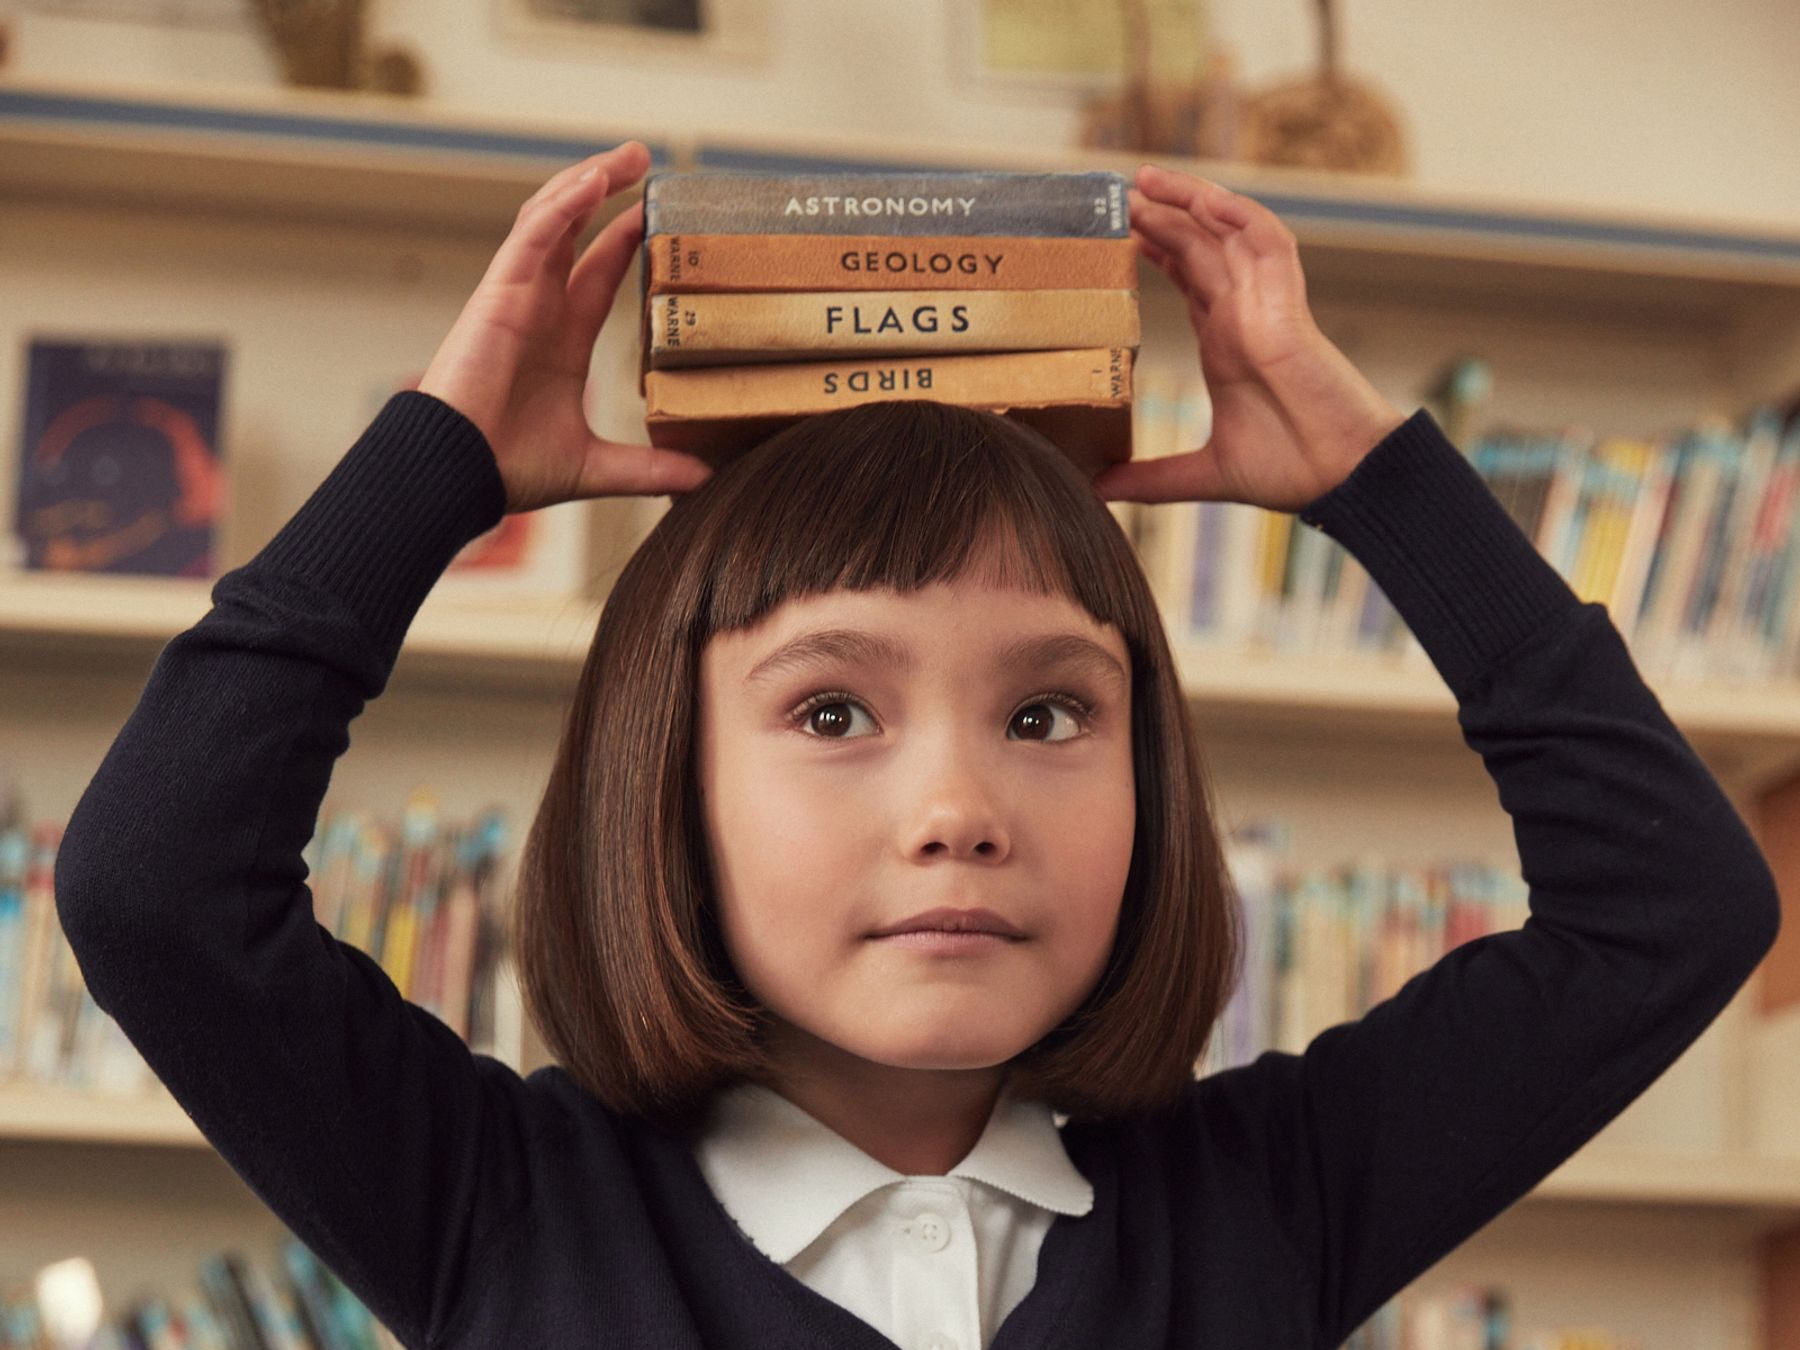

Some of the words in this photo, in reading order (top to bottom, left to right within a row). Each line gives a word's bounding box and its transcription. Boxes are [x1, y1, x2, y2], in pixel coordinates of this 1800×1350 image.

[784, 196, 977, 217] ASTRONOMY
[670, 235, 681, 282] WARNE
[840, 252, 1004, 275] GEOLOGY
[667, 296, 680, 347] WARNE
[684, 310, 697, 327] 29
[825, 306, 970, 334] FLAGS
[823, 368, 933, 394] BIRDS
